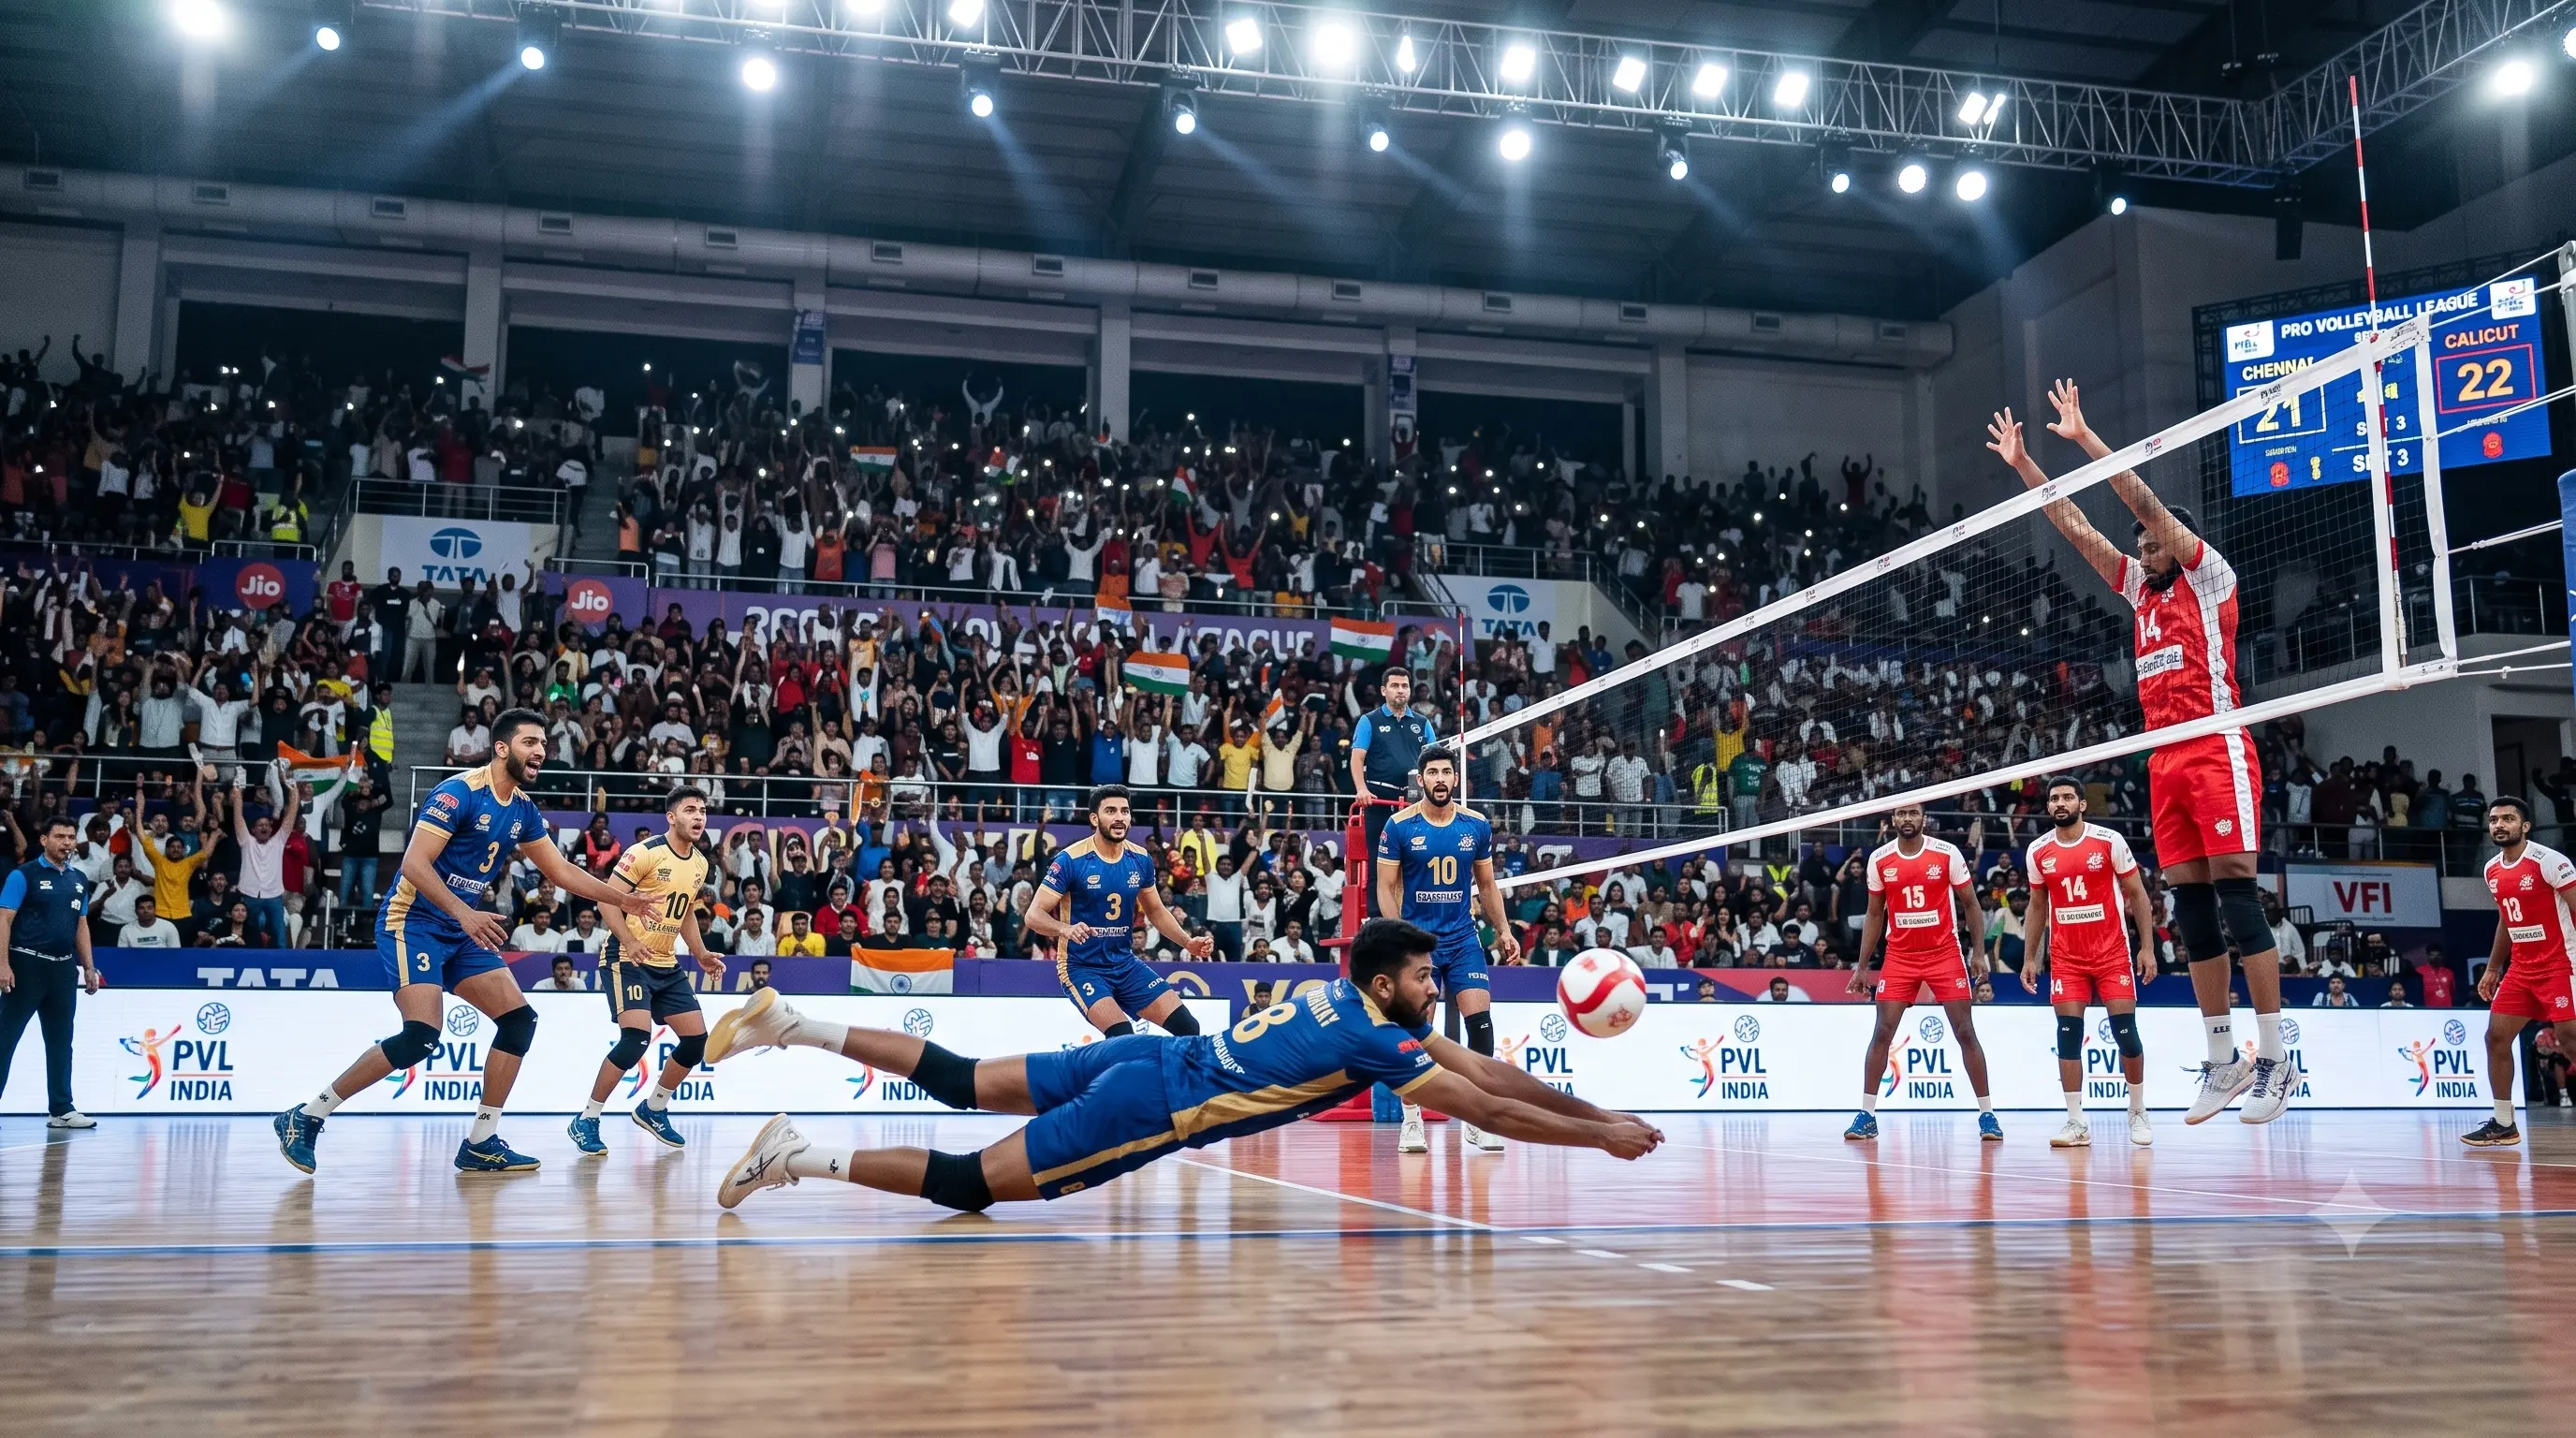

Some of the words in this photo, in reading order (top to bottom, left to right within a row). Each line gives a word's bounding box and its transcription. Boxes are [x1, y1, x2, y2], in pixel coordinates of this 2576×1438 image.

[2281, 321, 2313, 339] PRO
[2316, 302, 2413, 332] VOLLEYBALL
[2417, 292, 2479, 315] LEAGUE
[2445, 324, 2519, 349] CALICUT
[2457, 359, 2514, 402] 22
[2256, 395, 2302, 433] 21
[2396, 415, 2407, 431] 3
[2397, 448, 2409, 466] 3
[242, 575, 281, 596] Jio
[422, 565, 487, 583] TATA
[572, 590, 609, 610] Jio
[1482, 619, 1537, 637] TATA
[2138, 608, 2161, 648] 14
[479, 842, 500, 873] 3
[1427, 856, 1457, 886] 10
[1902, 885, 1925, 909] 15
[2061, 874, 2088, 902] 14
[2333, 881, 2393, 914] VFI
[665, 890, 689, 919] 10
[1105, 892, 1122, 920] 3
[417, 952, 431, 972] 3
[197, 967, 340, 988] TATA
[1083, 983, 1095, 996] 3
[626, 985, 643, 1001] 10
[1232, 1002, 1296, 1043] 8
[172, 1040, 233, 1070] PVL
[426, 1042, 483, 1071] PVL
[1526, 1047, 1573, 1074] PVL
[1720, 1048, 1766, 1073] PVL
[1908, 1049, 1952, 1073] PVL
[2434, 1050, 2474, 1074] PVL
[170, 1080, 232, 1100] INDIA
[424, 1081, 482, 1100] INDIA
[1722, 1082, 1769, 1099] INDIA
[1909, 1082, 1954, 1098] INDIA
[2437, 1082, 2478, 1098] INDIA
